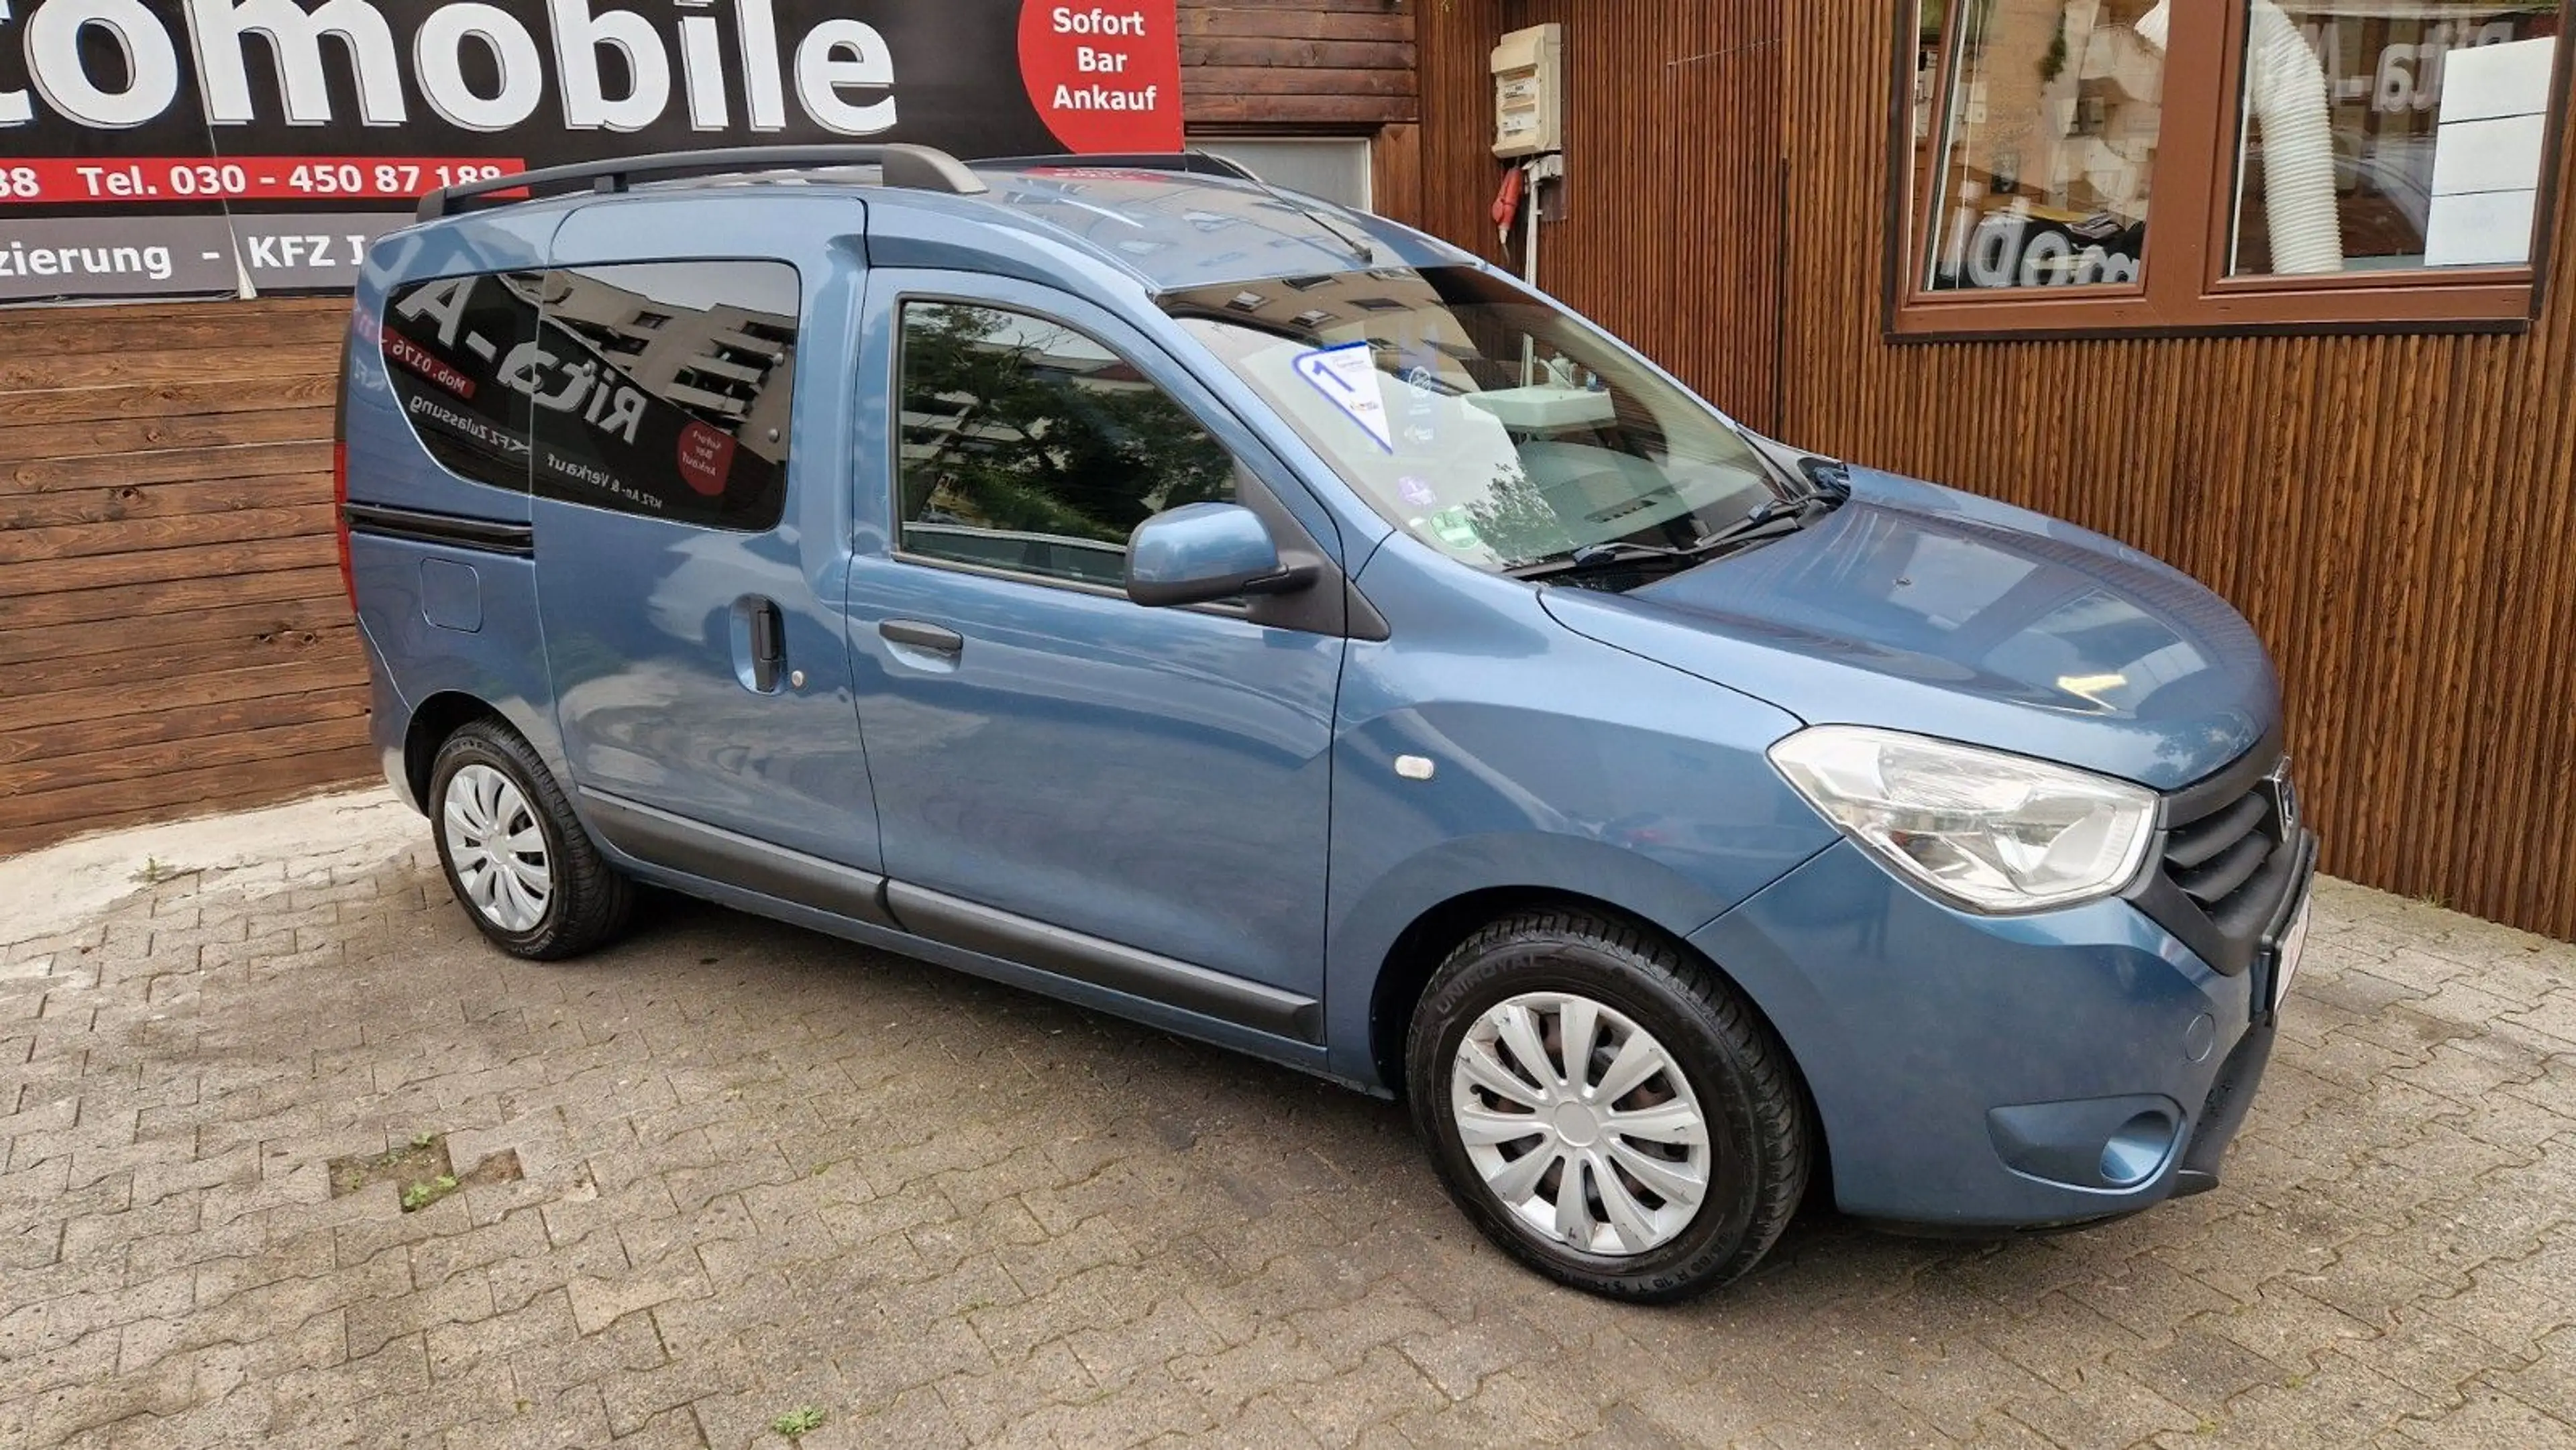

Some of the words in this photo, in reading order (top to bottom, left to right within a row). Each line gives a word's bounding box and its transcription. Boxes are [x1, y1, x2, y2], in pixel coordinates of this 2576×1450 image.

[1053, 7, 1146, 36] Sofort
[1077, 46, 1128, 72] Bar
[1053, 84, 1157, 110] Ankauf
[76, 166, 157, 196] Tel.
[170, 165, 246, 194] 030
[289, 165, 363, 192] 450
[374, 165, 419, 192] 87
[248, 235, 335, 268] KFZ
